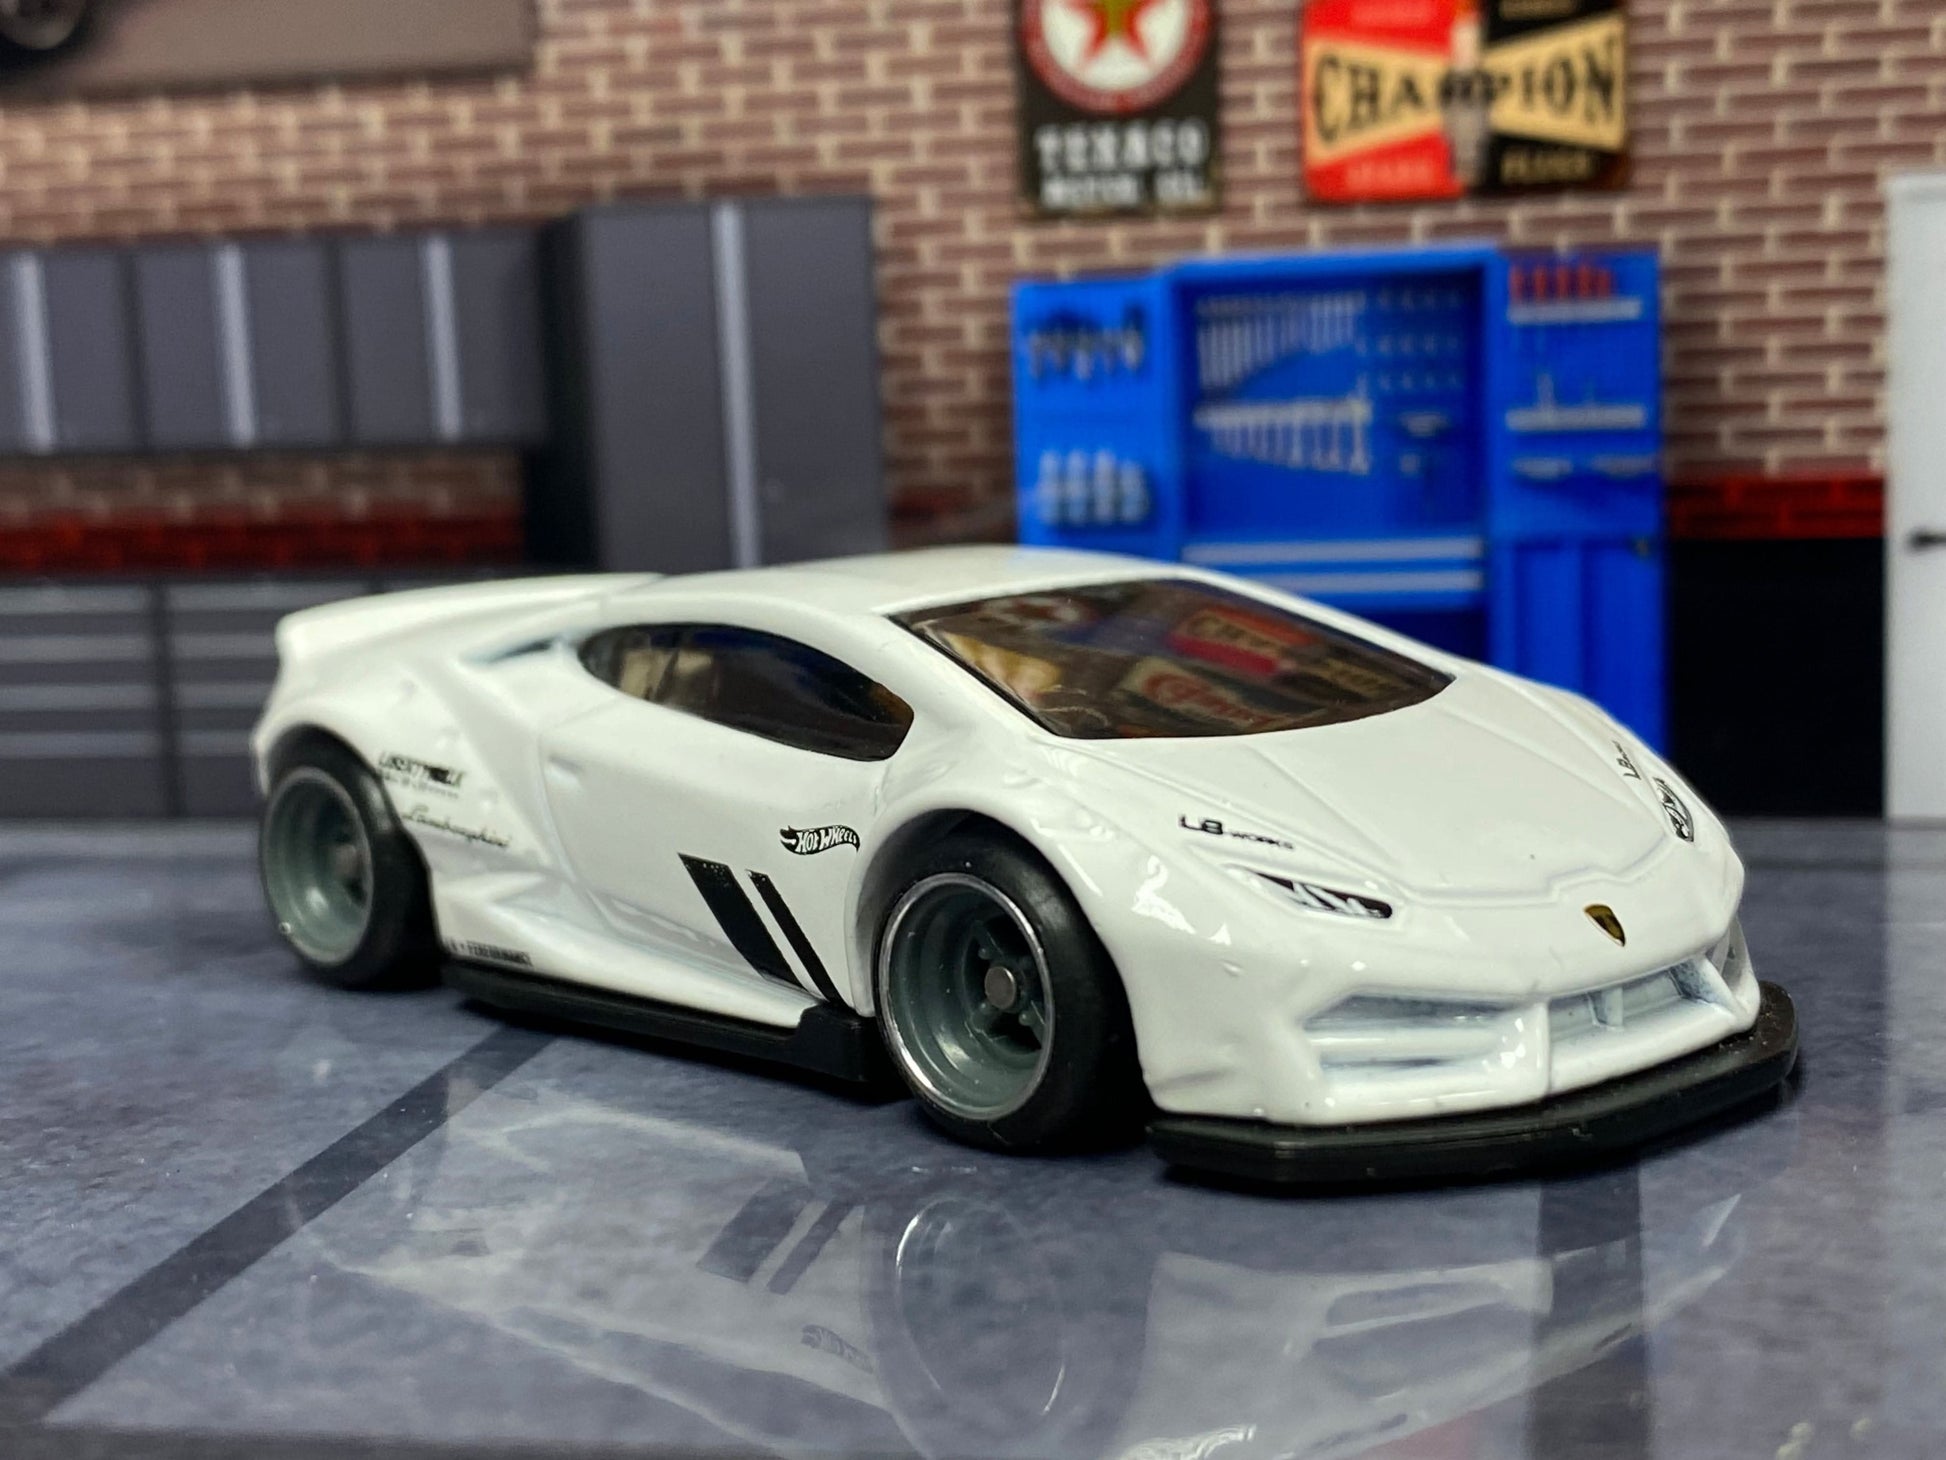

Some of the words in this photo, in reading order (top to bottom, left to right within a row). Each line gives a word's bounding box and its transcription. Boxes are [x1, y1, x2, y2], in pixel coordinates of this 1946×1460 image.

[1314, 36, 1617, 142] CHAMPION
[1034, 121, 1208, 174] TEXACO
[794, 831, 820, 853] HOT
